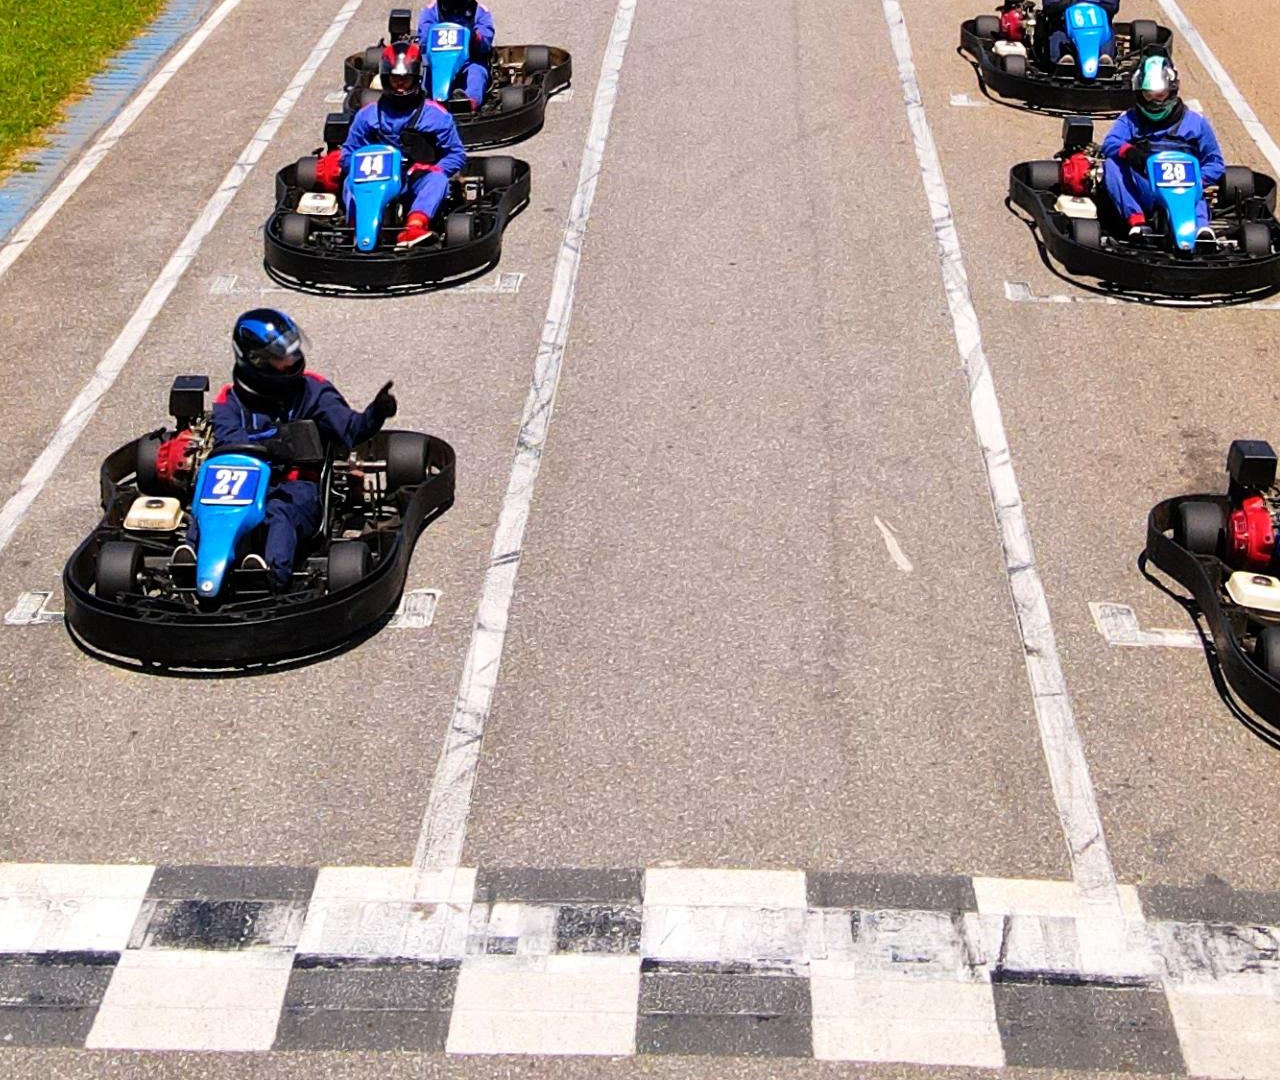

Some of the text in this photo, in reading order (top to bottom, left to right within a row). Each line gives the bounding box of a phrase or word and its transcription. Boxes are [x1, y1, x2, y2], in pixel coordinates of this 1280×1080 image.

[1074, 8, 1098, 26] 61
[359, 155, 384, 176] 44
[211, 469, 249, 496] 27
